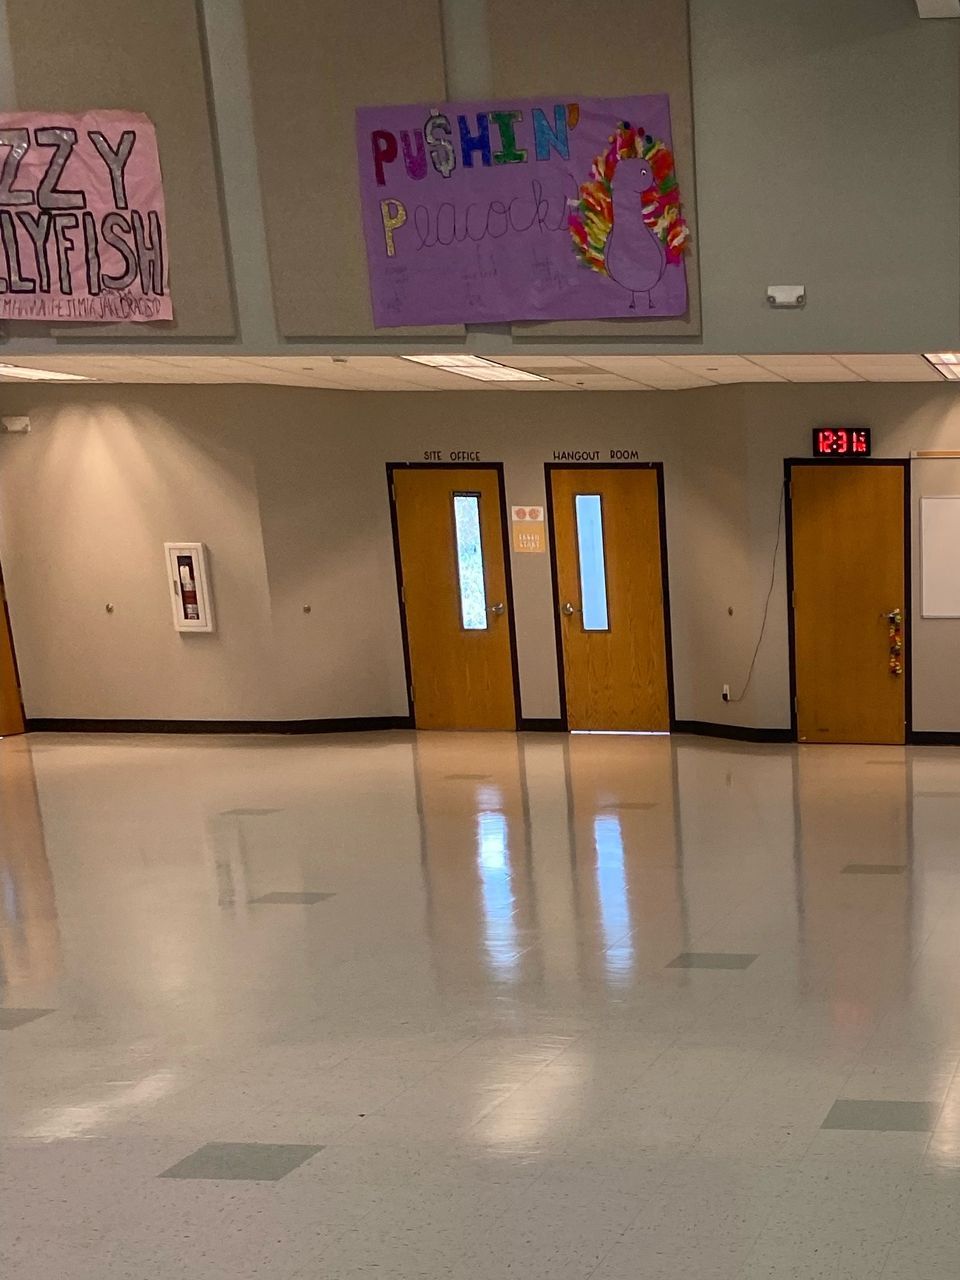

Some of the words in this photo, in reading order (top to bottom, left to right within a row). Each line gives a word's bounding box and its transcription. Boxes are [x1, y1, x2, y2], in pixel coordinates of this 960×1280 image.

[0, 209, 165, 297] LYFISH
[818, 431, 857, 453] 12:31
[423, 450, 443, 461] SITE
[450, 451, 480, 461] OFFICE
[553, 450, 600, 461] HANGOUT
[610, 450, 639, 460] ROOM
